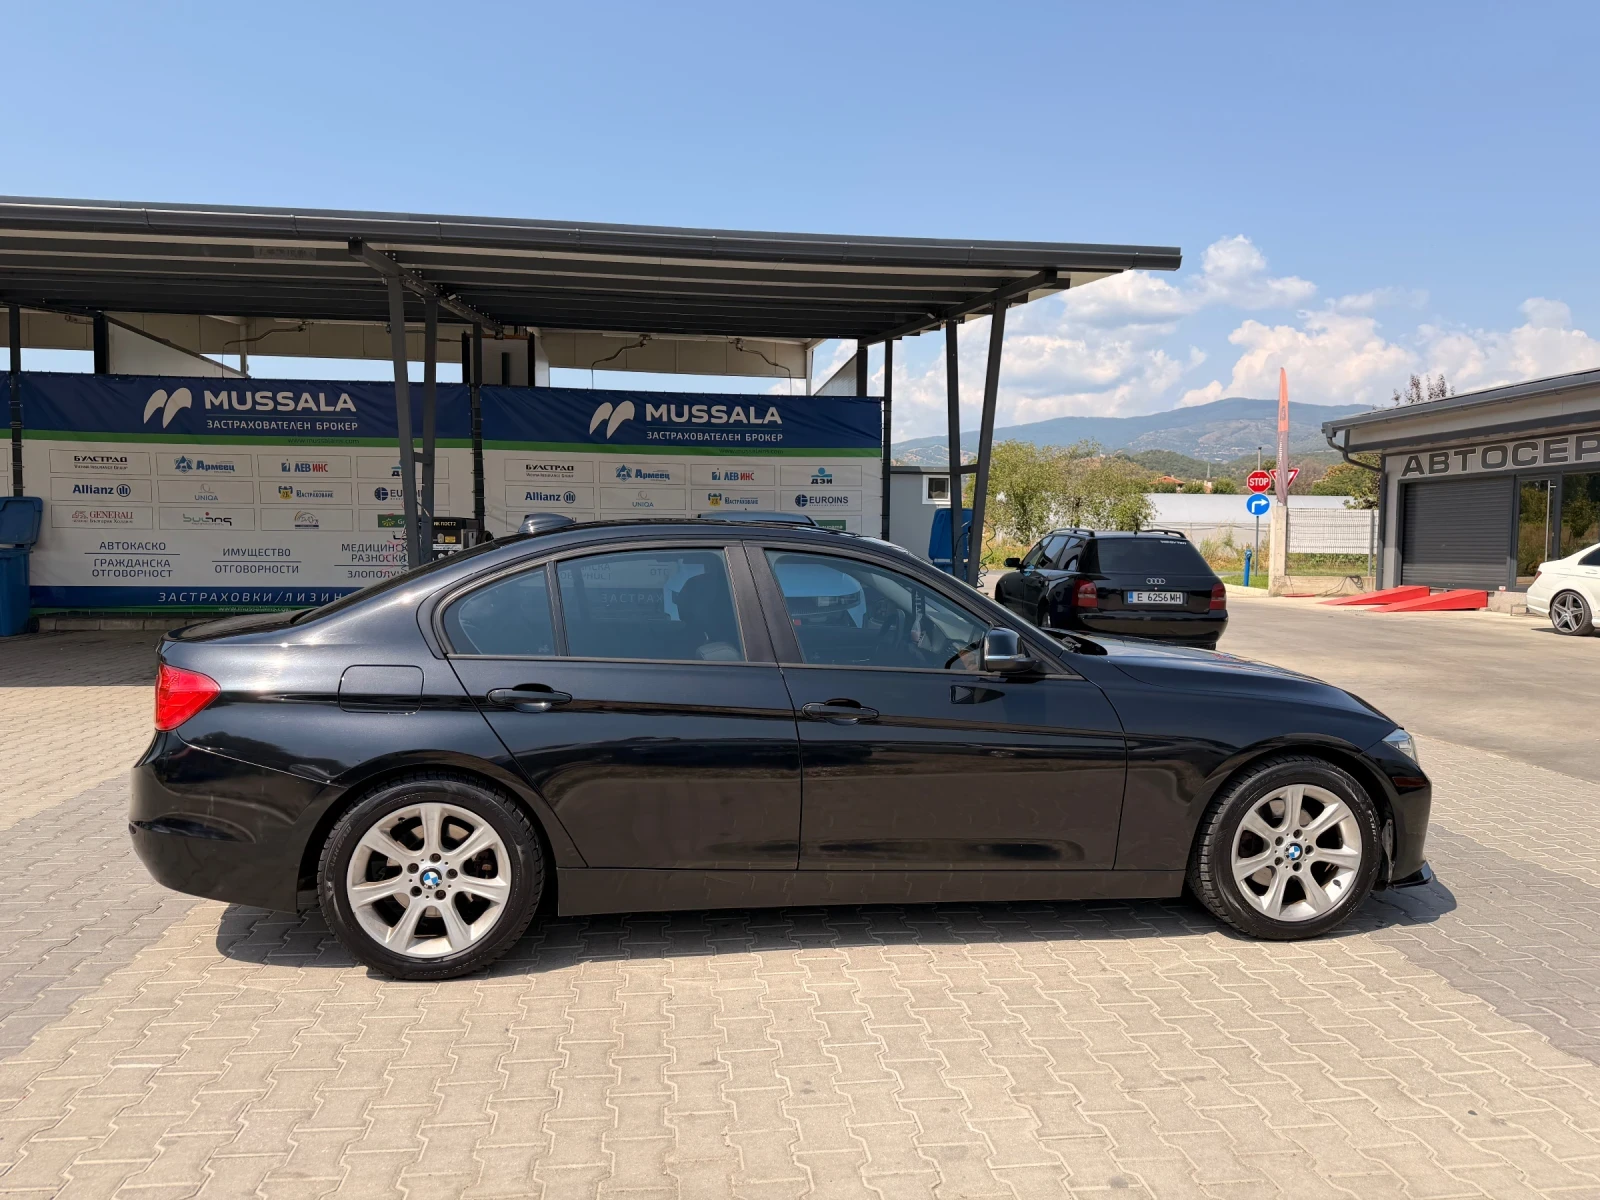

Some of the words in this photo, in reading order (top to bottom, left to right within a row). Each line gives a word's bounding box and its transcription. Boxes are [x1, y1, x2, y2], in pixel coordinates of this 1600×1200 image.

[203, 390, 357, 412] MUSSALA
[645, 403, 783, 424] MUSSALA
[206, 419, 311, 430] ЗАСТРАХОВАТЕЛЕН
[316, 422, 358, 431] БРОКЕР
[646, 431, 741, 441] ЗАСТРАХОВАТЕЛЕН
[745, 433, 783, 442] БРОКЕР
[196, 460, 236, 472] Армеец
[294, 462, 311, 473] ЛЕВ
[312, 463, 329, 473] ИНС
[634, 468, 671, 480] Армеец
[724, 471, 739, 481] ЛЕВ
[740, 472, 755, 481] ИНС
[1249, 477, 1269, 487] STOP
[72, 484, 115, 495] Allianz
[525, 491, 562, 502] Allianz
[809, 496, 849, 504] EUROINS
[89, 510, 135, 520] GENERALI
[99, 541, 167, 551] АВТОКАСКО
[341, 543, 408, 553] МЕДИЦИНСК
[222, 548, 291, 559] ИМУЩЕСТВО
[351, 554, 406, 563] РАЗНОСКИ
[94, 558, 171, 569] ГРАЖДАНСКА
[214, 564, 299, 574] ОТГОВОРНОСТИ
[92, 569, 173, 578] ОТГОВОРНОСТ
[158, 592, 342, 604] ЗАСТРАХОВКИ/ЛИЗИН
[1137, 592, 1143, 602] E
[1147, 592, 1169, 602] 6256
[1169, 593, 1182, 603] MH
